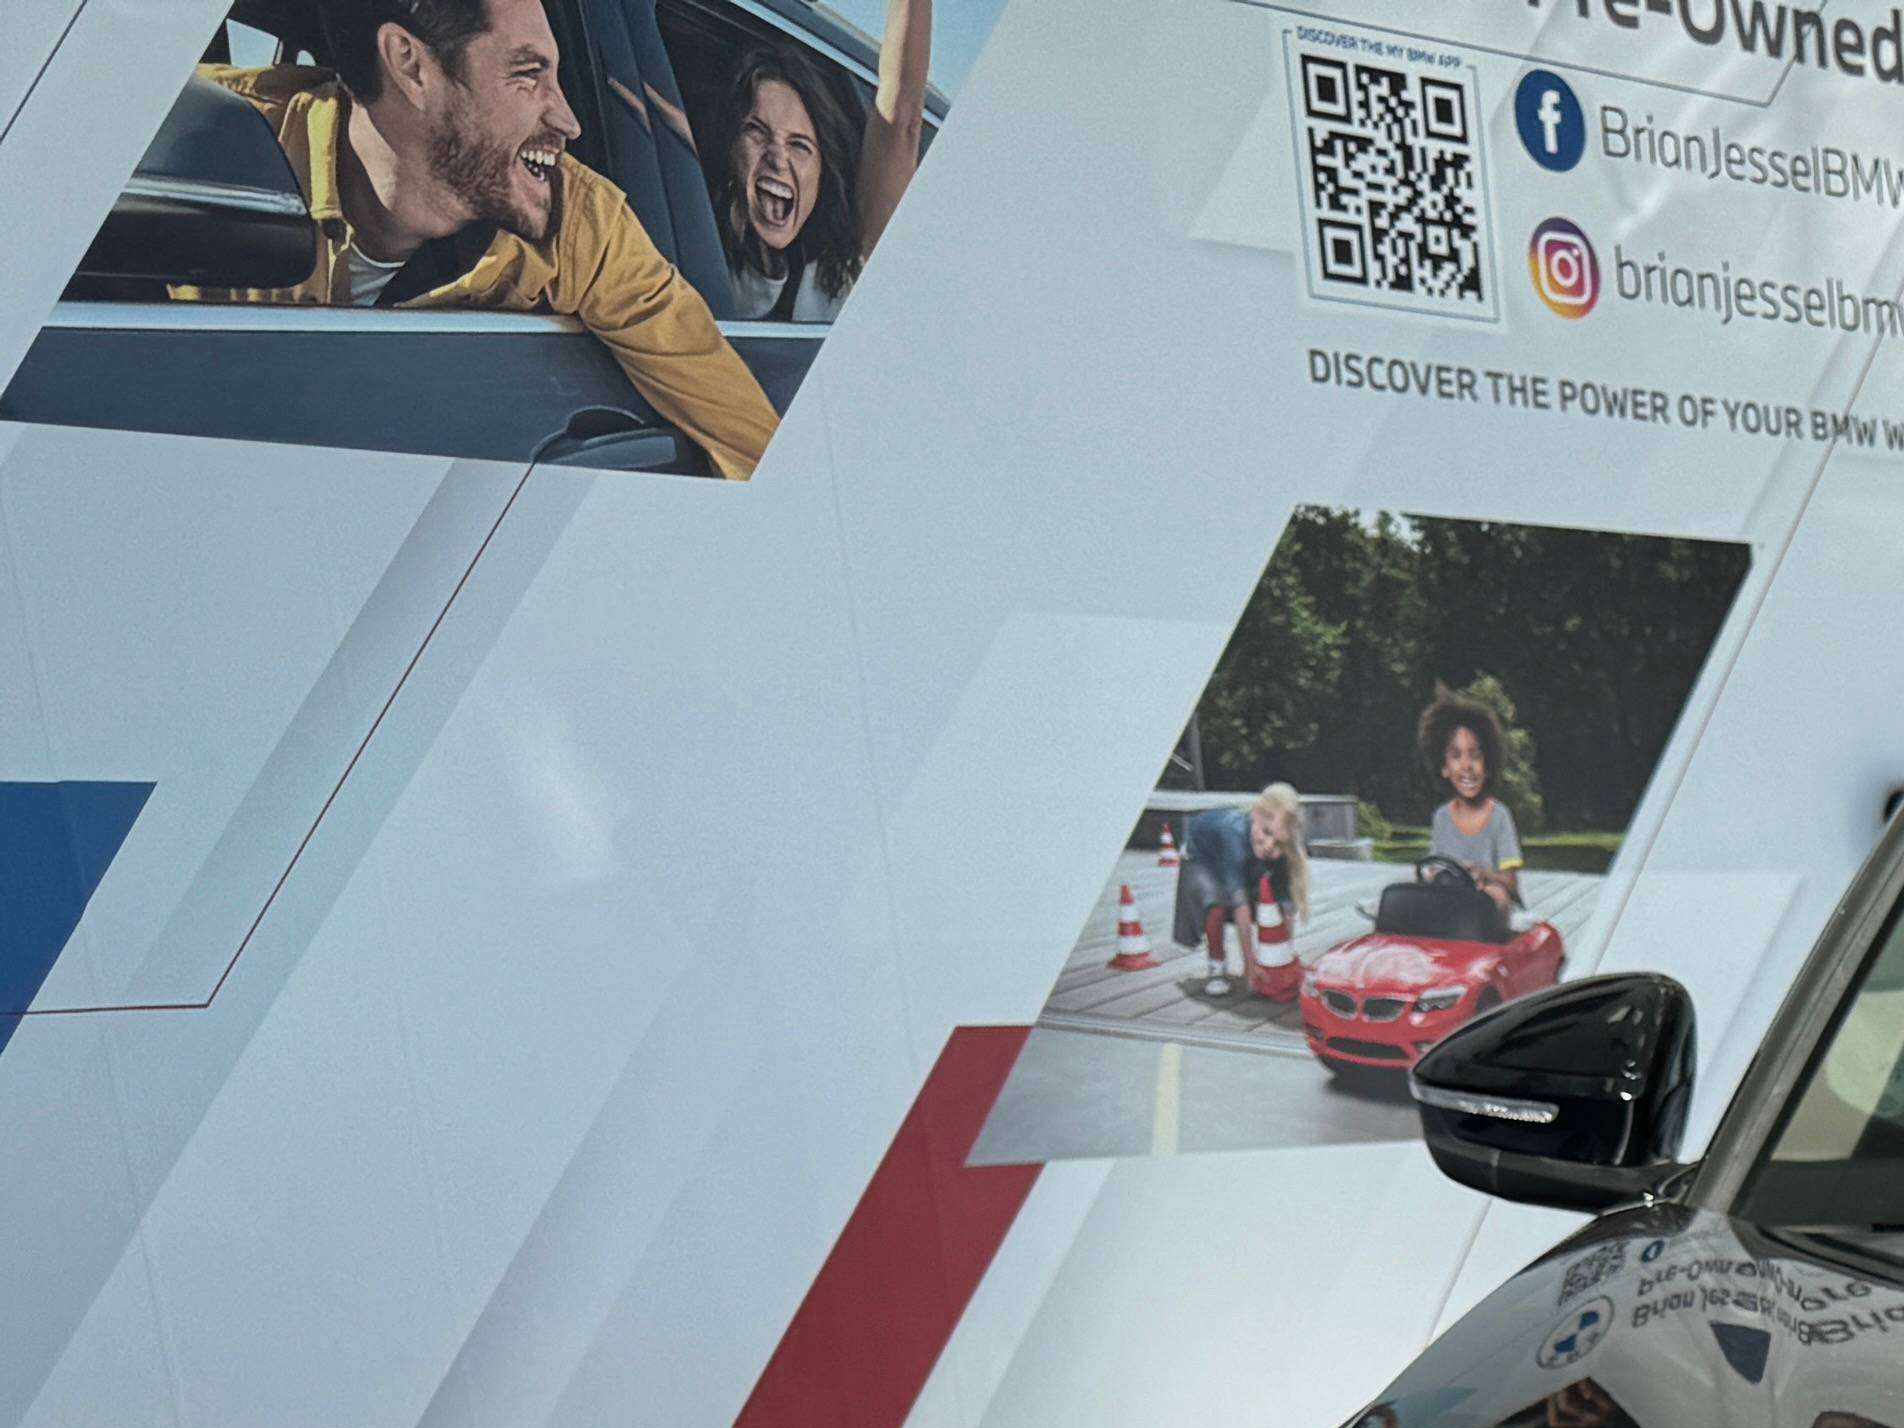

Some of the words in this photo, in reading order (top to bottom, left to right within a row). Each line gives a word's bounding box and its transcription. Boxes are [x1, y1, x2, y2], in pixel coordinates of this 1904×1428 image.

[1296, 25, 1359, 49] DISCOVER
[1307, 348, 1479, 402] DISCOVER
[1484, 369, 1552, 409] THE
[1558, 377, 1672, 425] POWER
[1677, 393, 1718, 428] OF
[1722, 398, 1803, 440] YOUR
[1810, 409, 1877, 448] BMW
